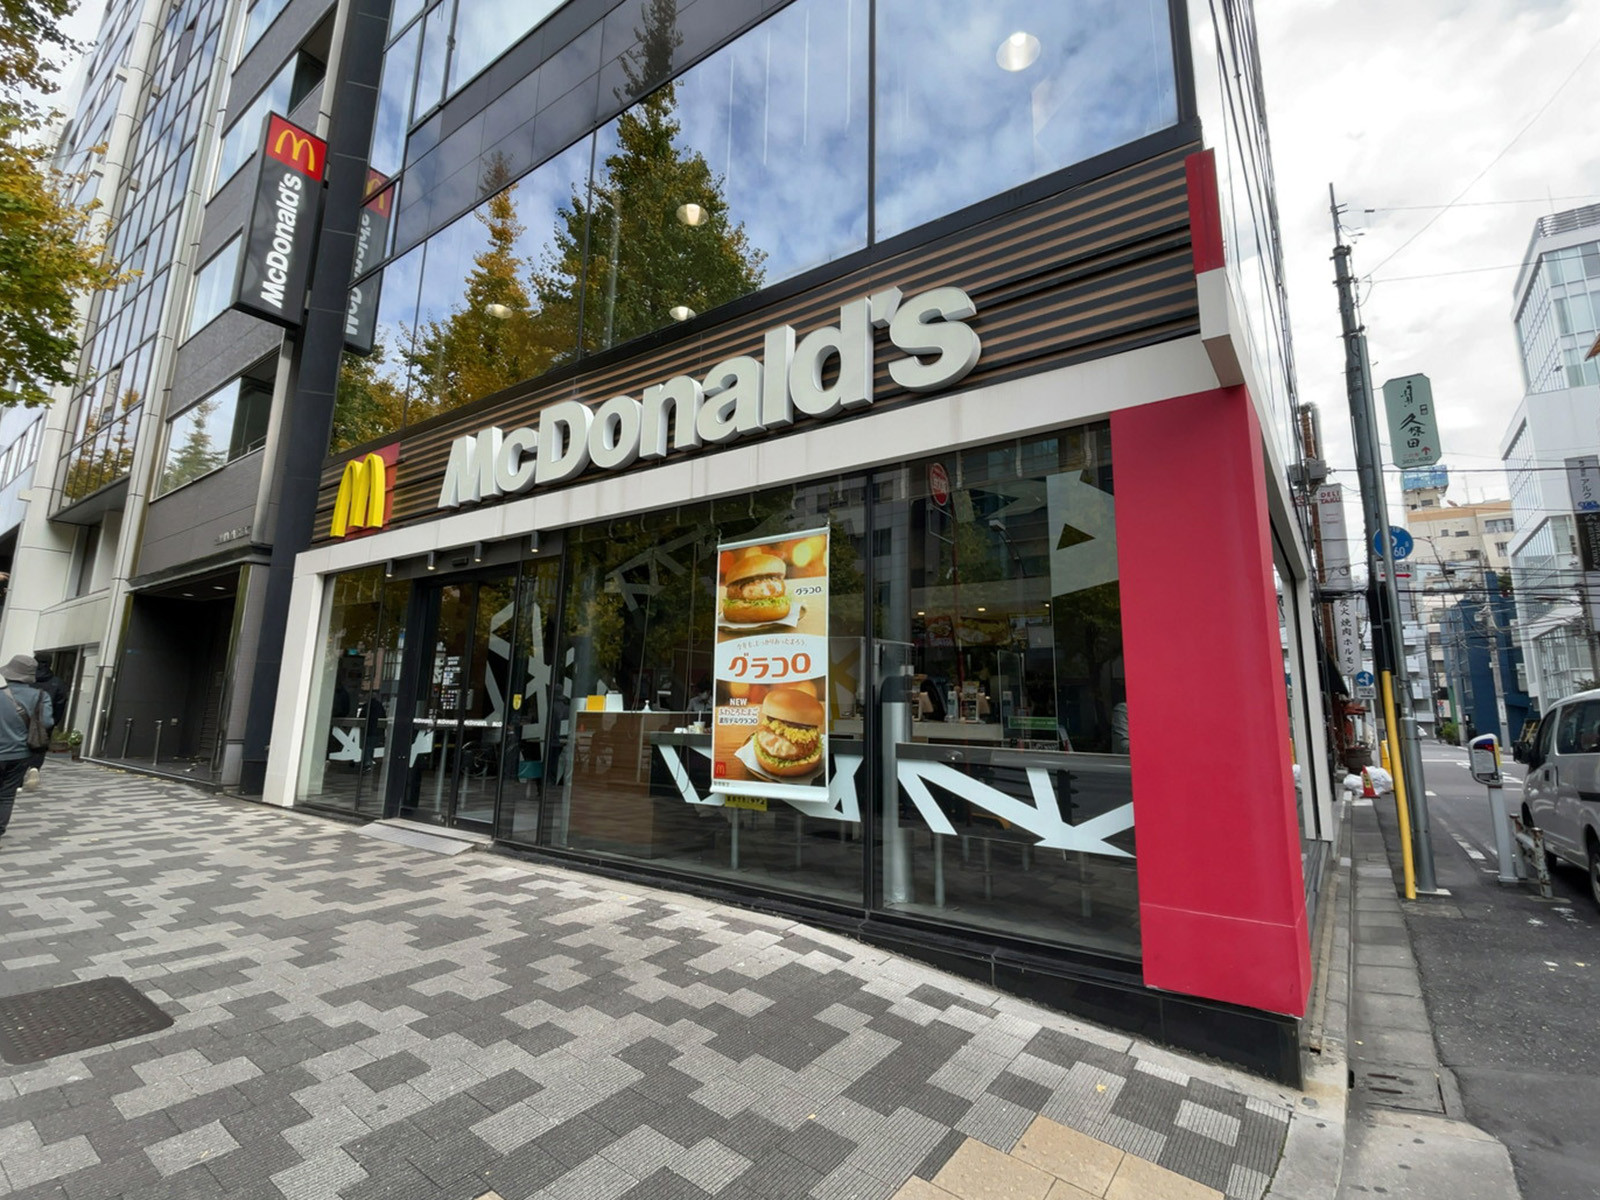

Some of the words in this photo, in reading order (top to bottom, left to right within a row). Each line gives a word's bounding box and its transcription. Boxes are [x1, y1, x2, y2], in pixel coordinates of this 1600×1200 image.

[260, 173, 303, 310] McDonald's
[438, 286, 982, 509] McDonald's
[1399, 413, 1425, 448] 久保田
[1394, 546, 1405, 557] 60
[795, 585, 822, 596] グラコロ
[728, 652, 811, 679] グラコロ
[729, 698, 748, 706] NEW
